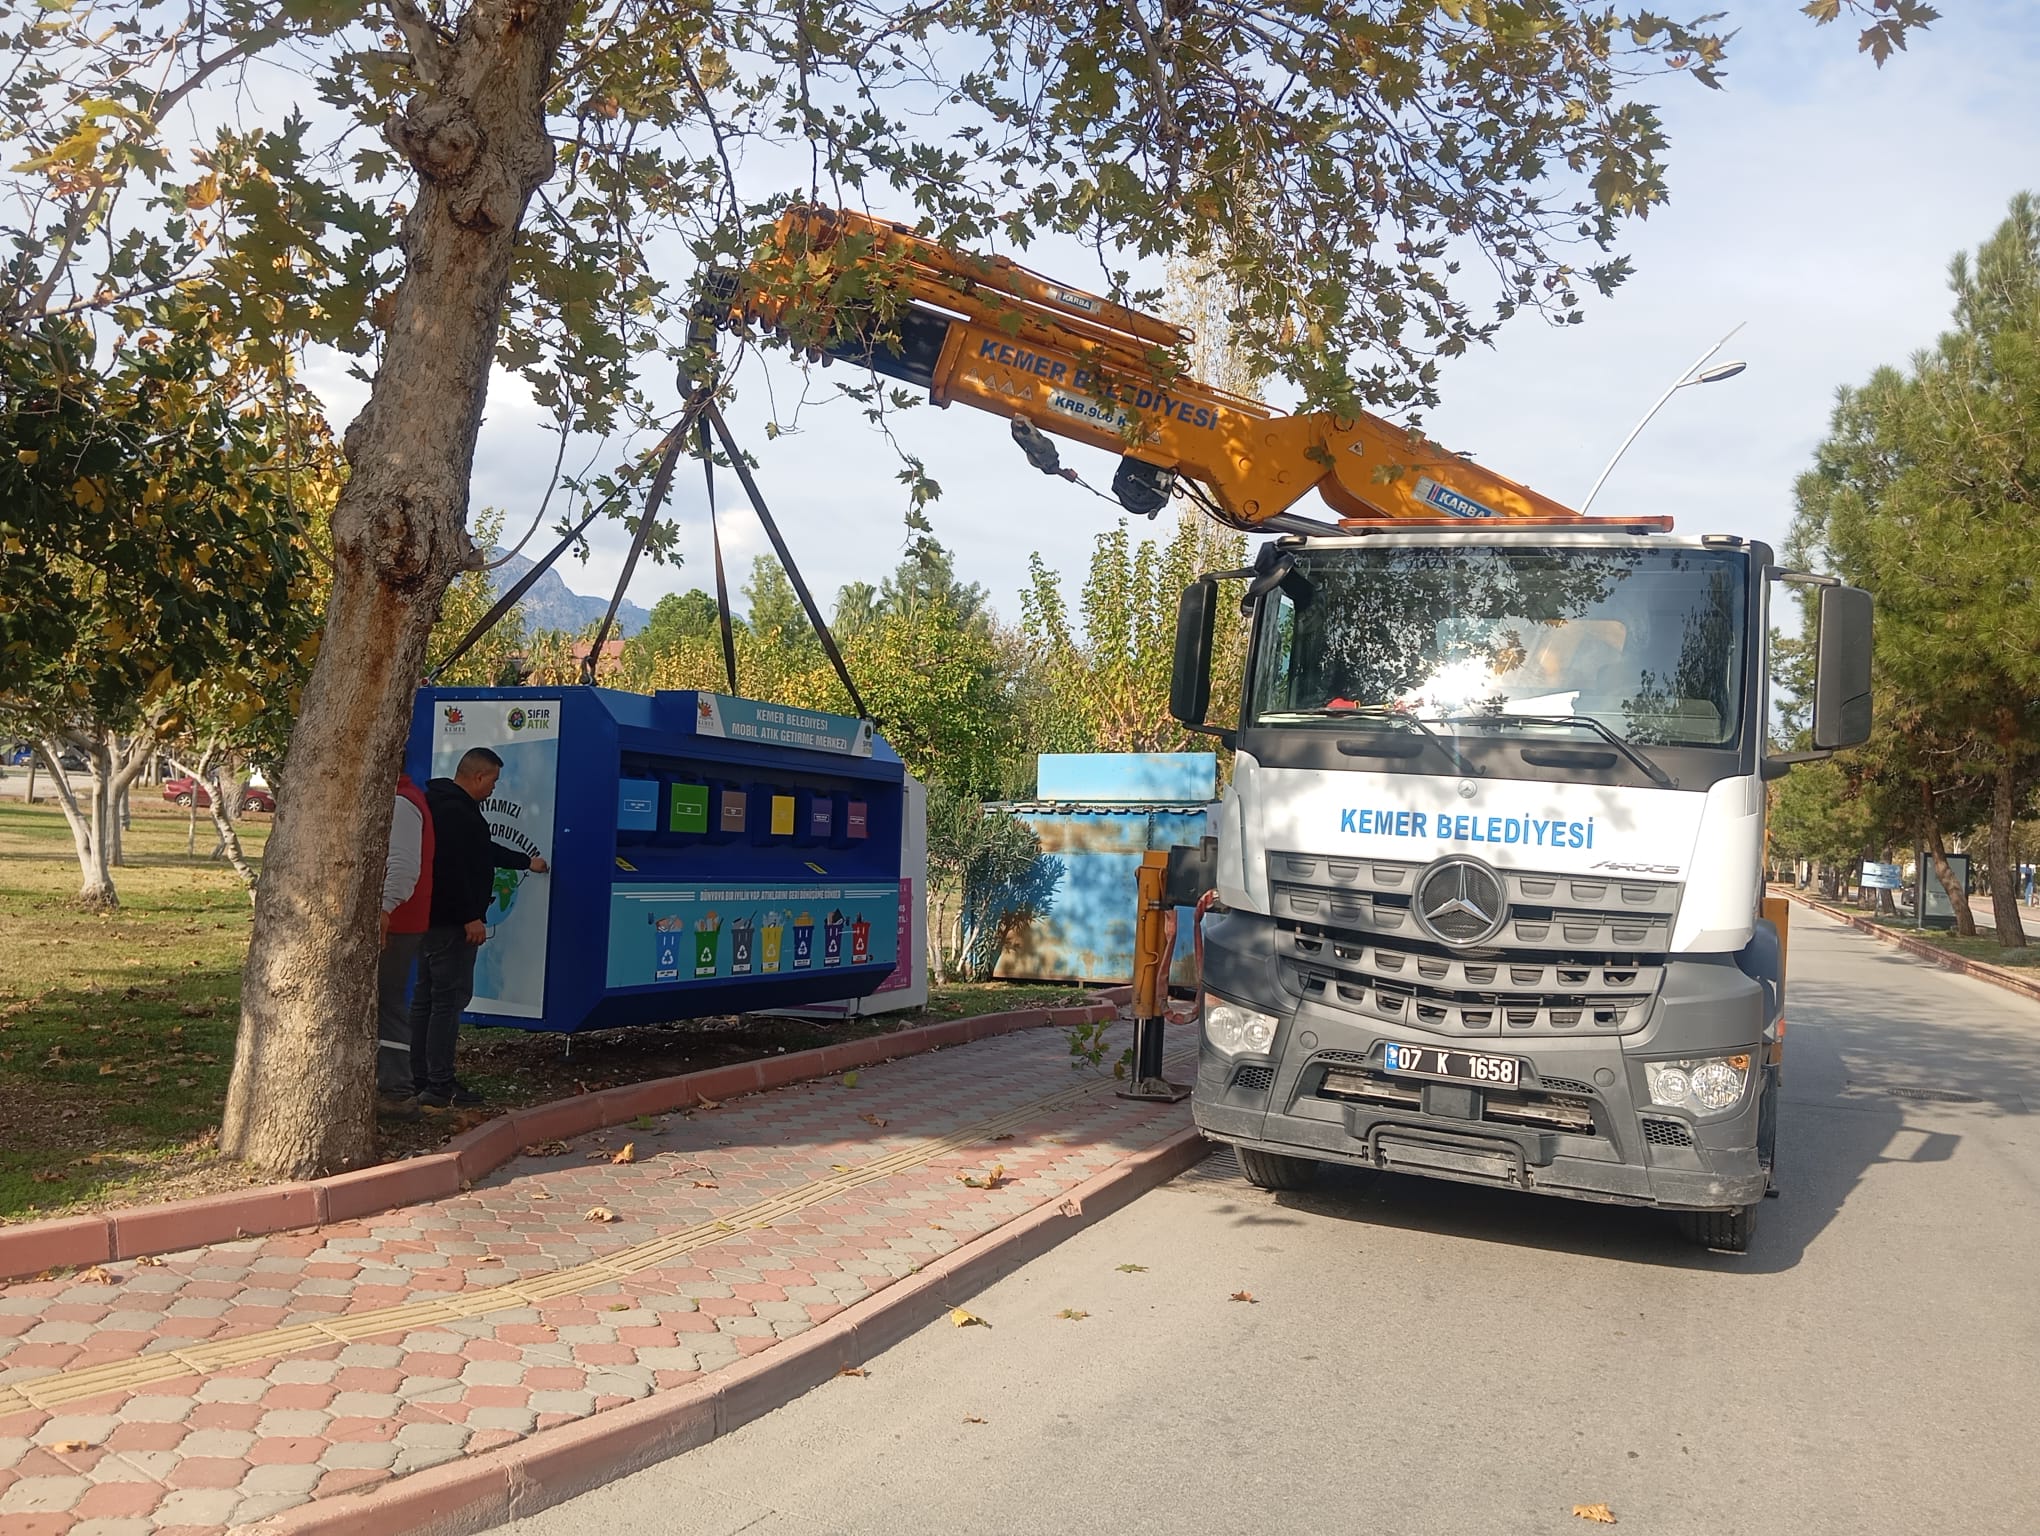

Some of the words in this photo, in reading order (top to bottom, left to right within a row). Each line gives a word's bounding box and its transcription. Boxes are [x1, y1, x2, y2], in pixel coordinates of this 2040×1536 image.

[1062, 293, 1090, 309] KARBA
[979, 338, 1067, 383] KEMER
[1073, 368, 1220, 431] BLEDİYESİ
[1439, 491, 1485, 517] KARBA
[527, 709, 550, 719] SIFIR
[527, 719, 550, 729] ATIK
[756, 708, 784, 724] KEMER
[760, 727, 779, 741] ATIK
[1340, 808, 1427, 838] KEMER
[1437, 812, 1595, 850] BELEDİYESİ
[488, 822, 541, 858] ORUYALIM
[1399, 1047, 1422, 1070] 07
[1437, 1052, 1449, 1074] K
[1468, 1056, 1513, 1082] 1658
